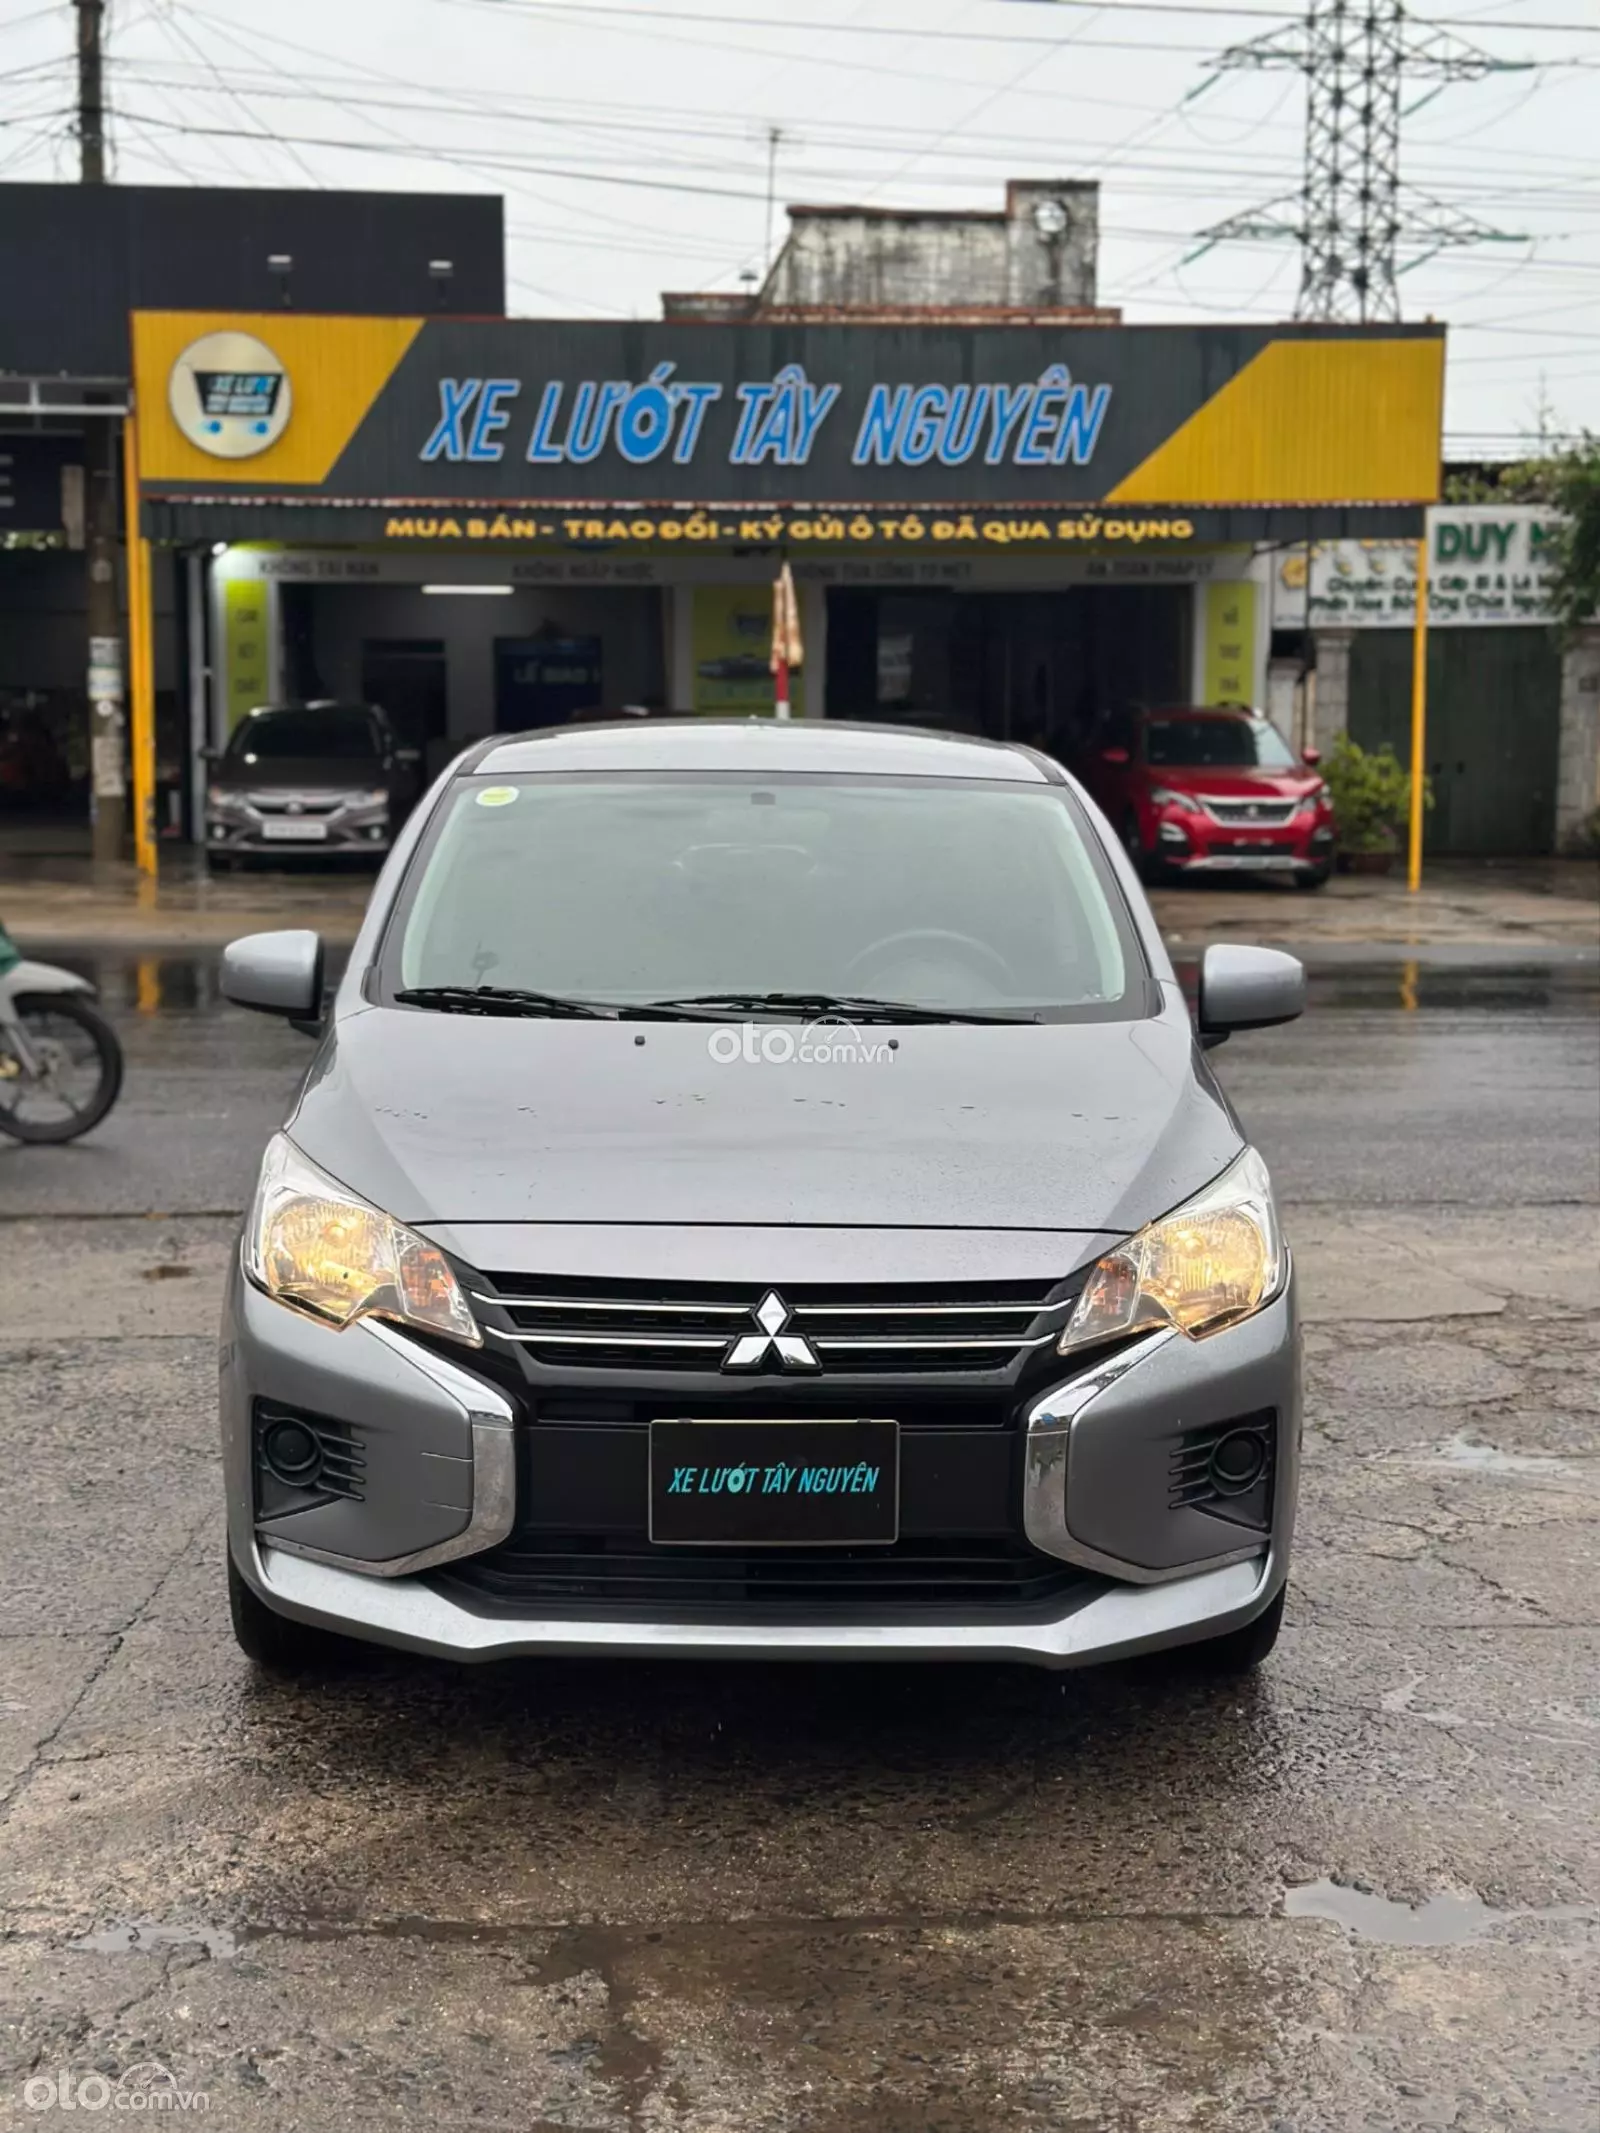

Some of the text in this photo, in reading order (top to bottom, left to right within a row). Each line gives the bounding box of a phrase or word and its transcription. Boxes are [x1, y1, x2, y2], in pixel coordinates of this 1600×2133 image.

[419, 361, 1112, 466] XE LƯỚT TÂY NGUYÊN
[385, 517, 462, 538] MUA
[466, 513, 537, 539] BÁN
[563, 519, 656, 540] TRAO
[740, 513, 785, 540] KÝ
[848, 514, 874, 540] Ô
[877, 514, 925, 540] TÔ
[931, 514, 978, 540] ĐÃ
[982, 519, 1050, 543] QUA
[1103, 519, 1194, 544] DỤNG
[1436, 522, 1517, 563] DUY
[667, 1460, 880, 1494] XE LƯỚT TÂY NGUYÊN
